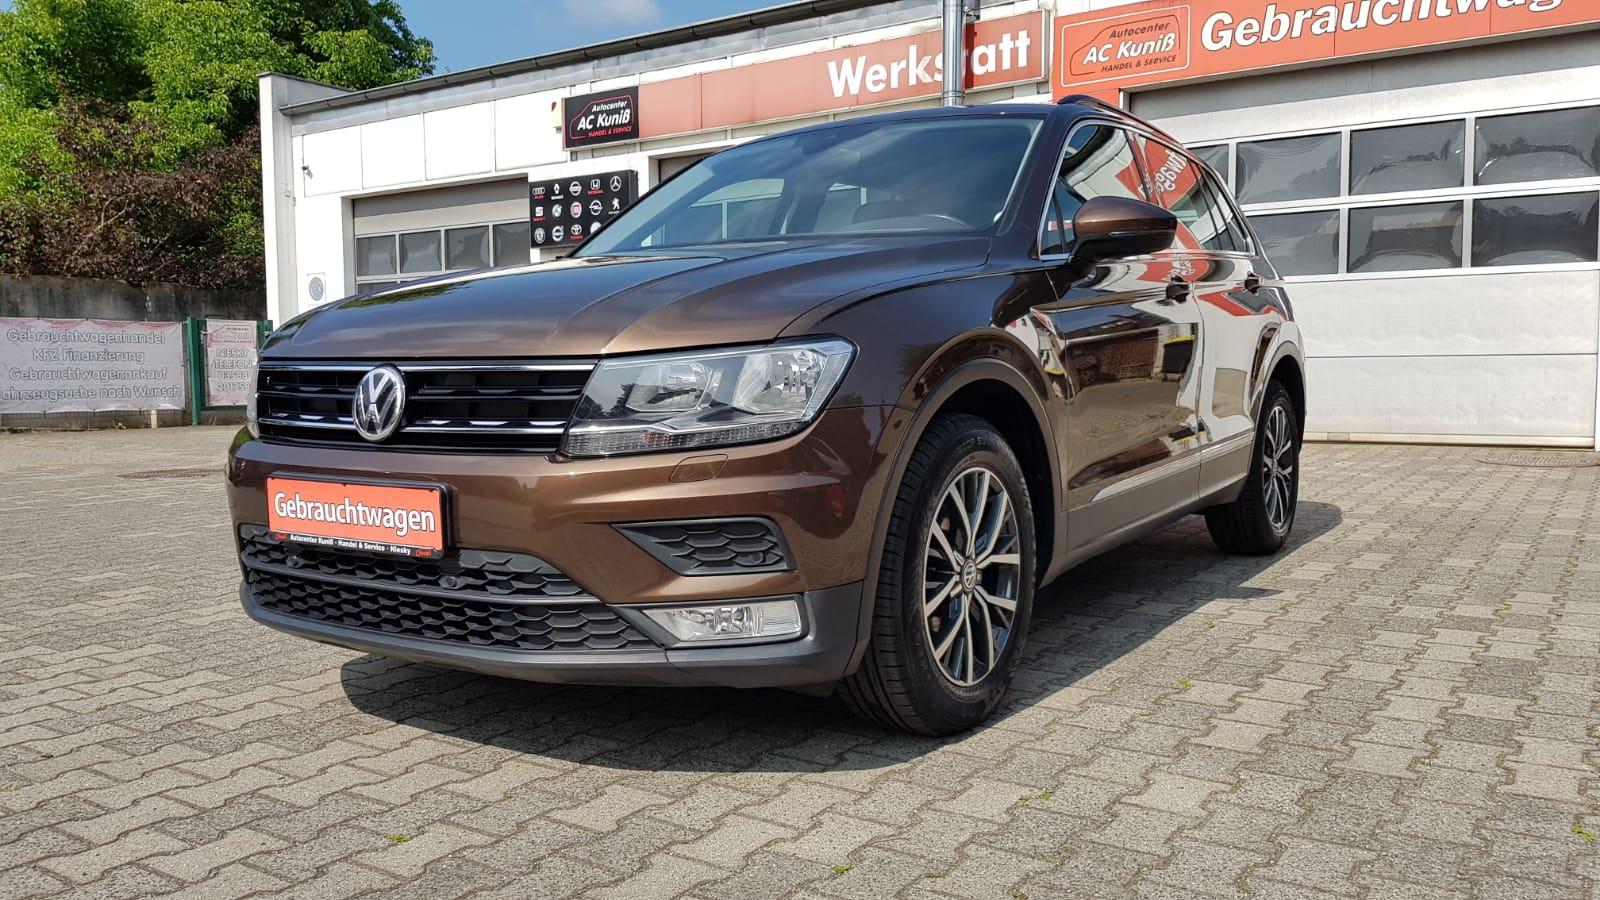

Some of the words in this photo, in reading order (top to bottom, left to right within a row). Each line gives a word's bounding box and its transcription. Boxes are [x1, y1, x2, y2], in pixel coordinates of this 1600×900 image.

[1109, 22, 1170, 39] Autocenter
[1083, 43, 1112, 65] AC
[1116, 32, 1175, 59] Kuniß
[827, 30, 1031, 98] Werksatt
[1101, 61, 1133, 73] HANDEL
[1135, 60, 1142, 68] &
[1143, 54, 1177, 67] SERVICE
[592, 100, 628, 113] Autocenter
[577, 115, 595, 131] AC
[596, 108, 631, 128] Kuniß
[6, 328, 165, 346] Gebrauchtwagenhandel
[33, 347, 60, 361] KFZ
[63, 347, 144, 365] Finanzierung
[216, 348, 249, 358] NIESKY
[214, 359, 253, 369] TELEFON
[9, 367, 168, 383] Gebrauchtwagenankauf
[218, 370, 249, 380] 03588
[100, 385, 132, 399] nach
[133, 384, 181, 399] Wunsch
[274, 492, 436, 538] Gebrauchtwagen
[290, 533, 317, 544] Autocenter
[390, 545, 411, 556] Niesky
